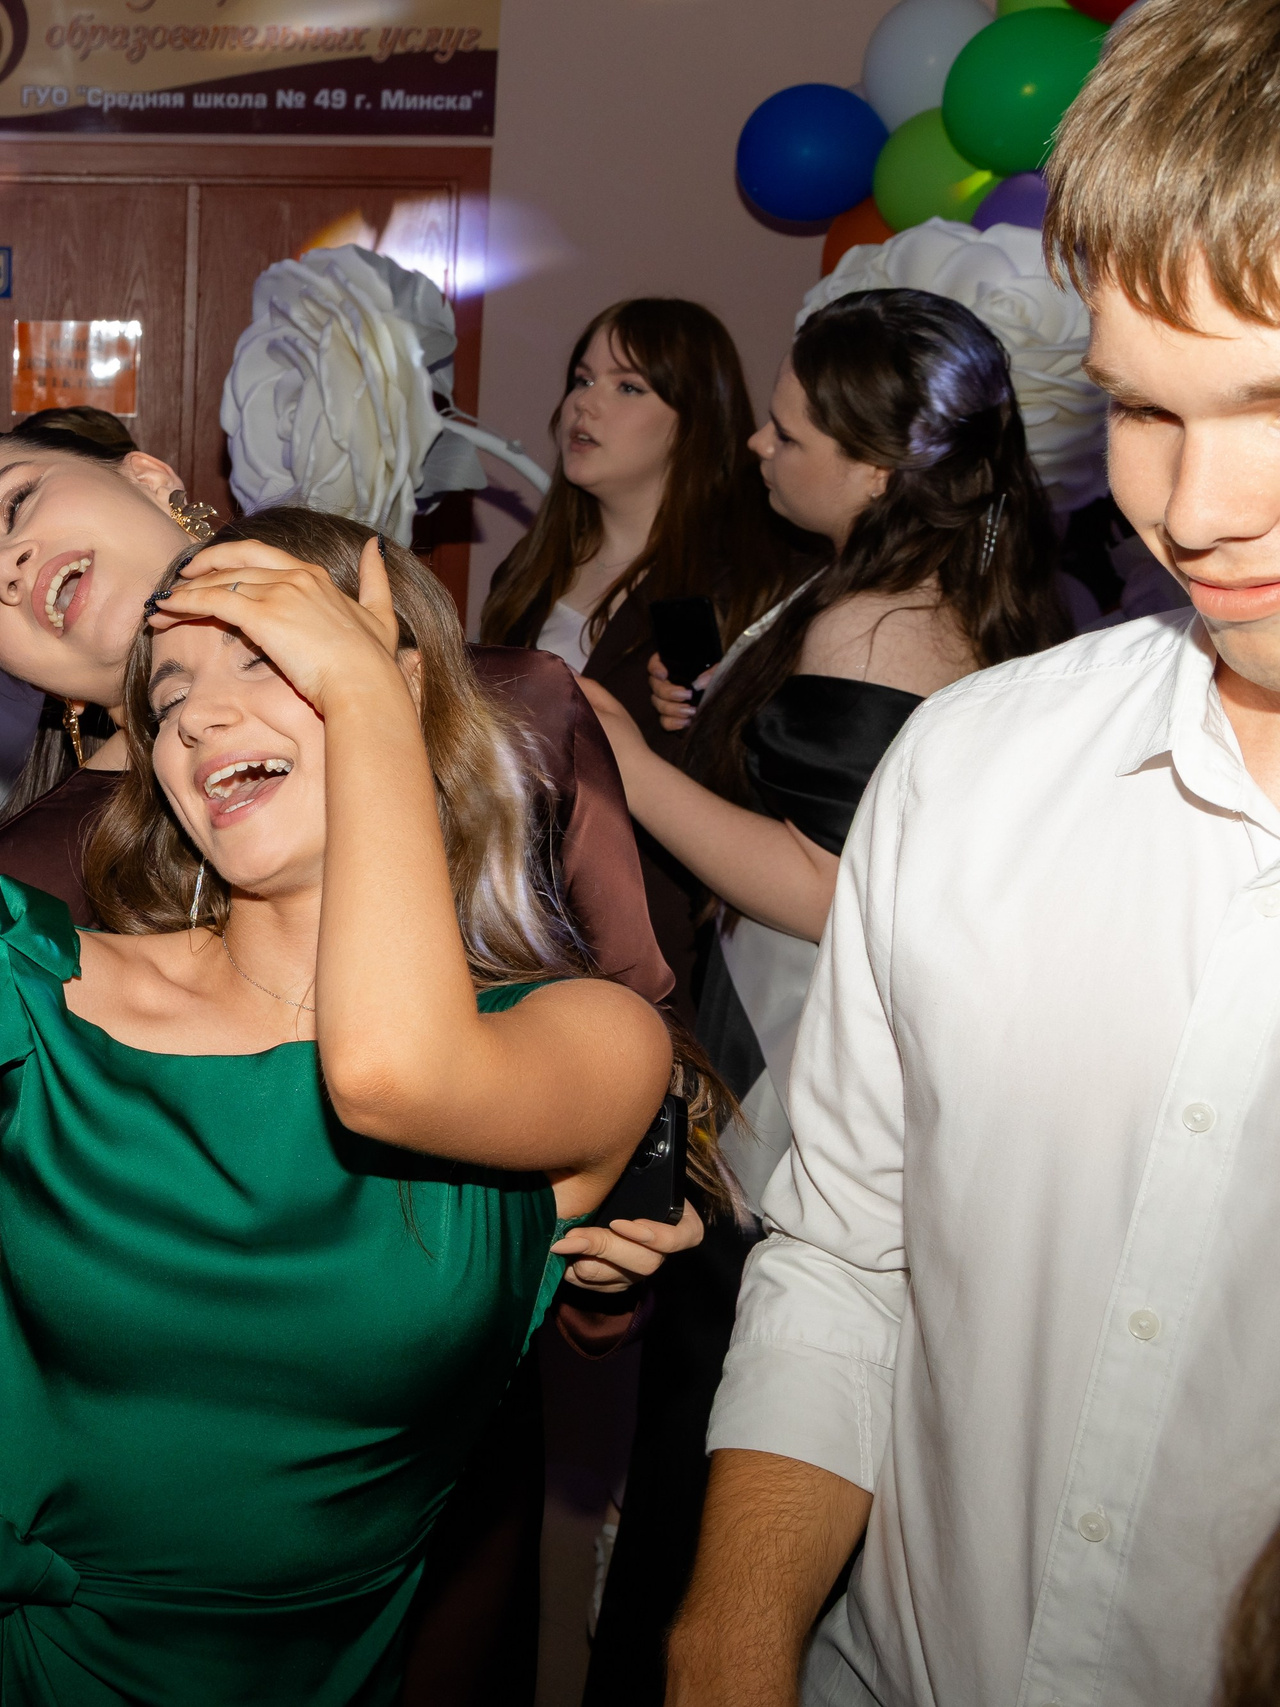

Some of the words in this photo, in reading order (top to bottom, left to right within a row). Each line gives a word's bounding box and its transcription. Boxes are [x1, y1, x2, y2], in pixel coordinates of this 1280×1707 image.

[46, 15, 369, 63] образовательных
[372, 25, 481, 64] услуг
[21, 86, 69, 107] ГУО
[77, 87, 185, 113] "Средняя
[192, 91, 267, 110] школа
[275, 88, 306, 110] №
[313, 88, 347, 110] 49
[354, 94, 371, 110] г.
[380, 88, 484, 111] Минска"
